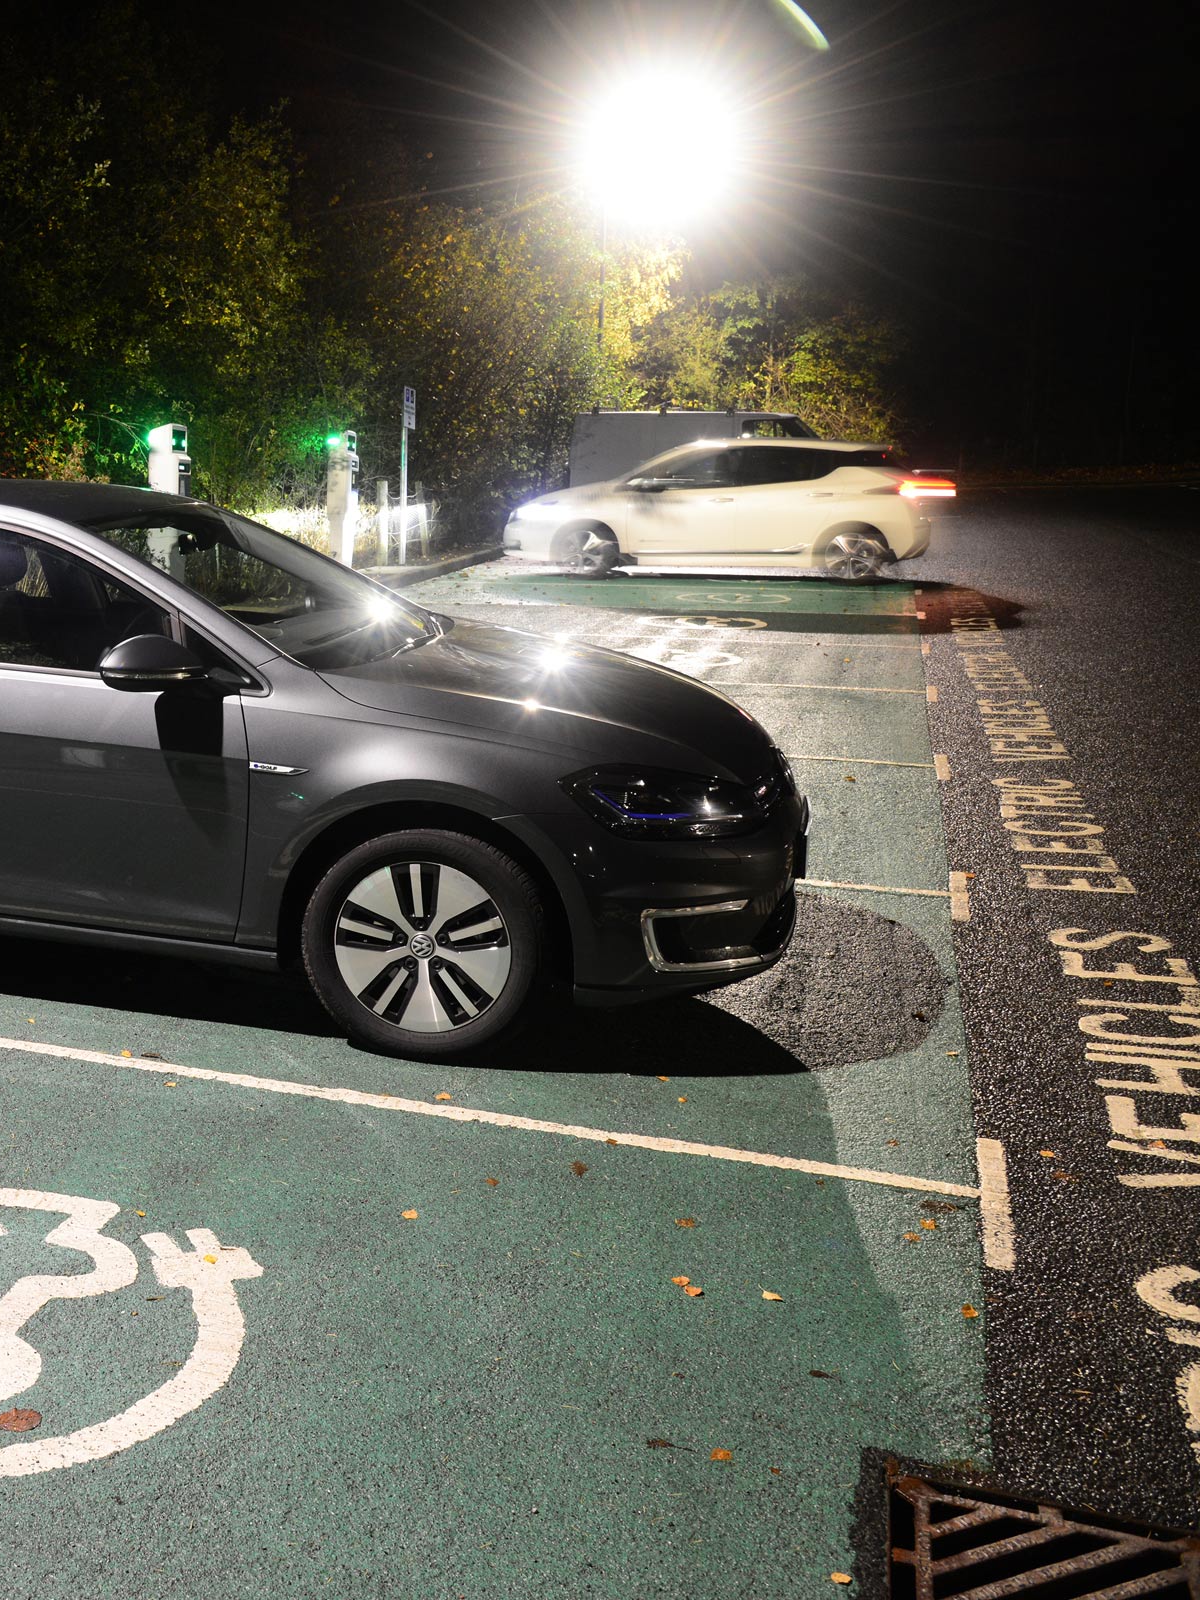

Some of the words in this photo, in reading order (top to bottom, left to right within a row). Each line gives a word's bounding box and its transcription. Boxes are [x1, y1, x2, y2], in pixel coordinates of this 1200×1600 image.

[976, 698, 1072, 762] VEHICLES
[990, 777, 1137, 894] ELECTRIC
[1048, 927, 1200, 1189] VEHICLES
